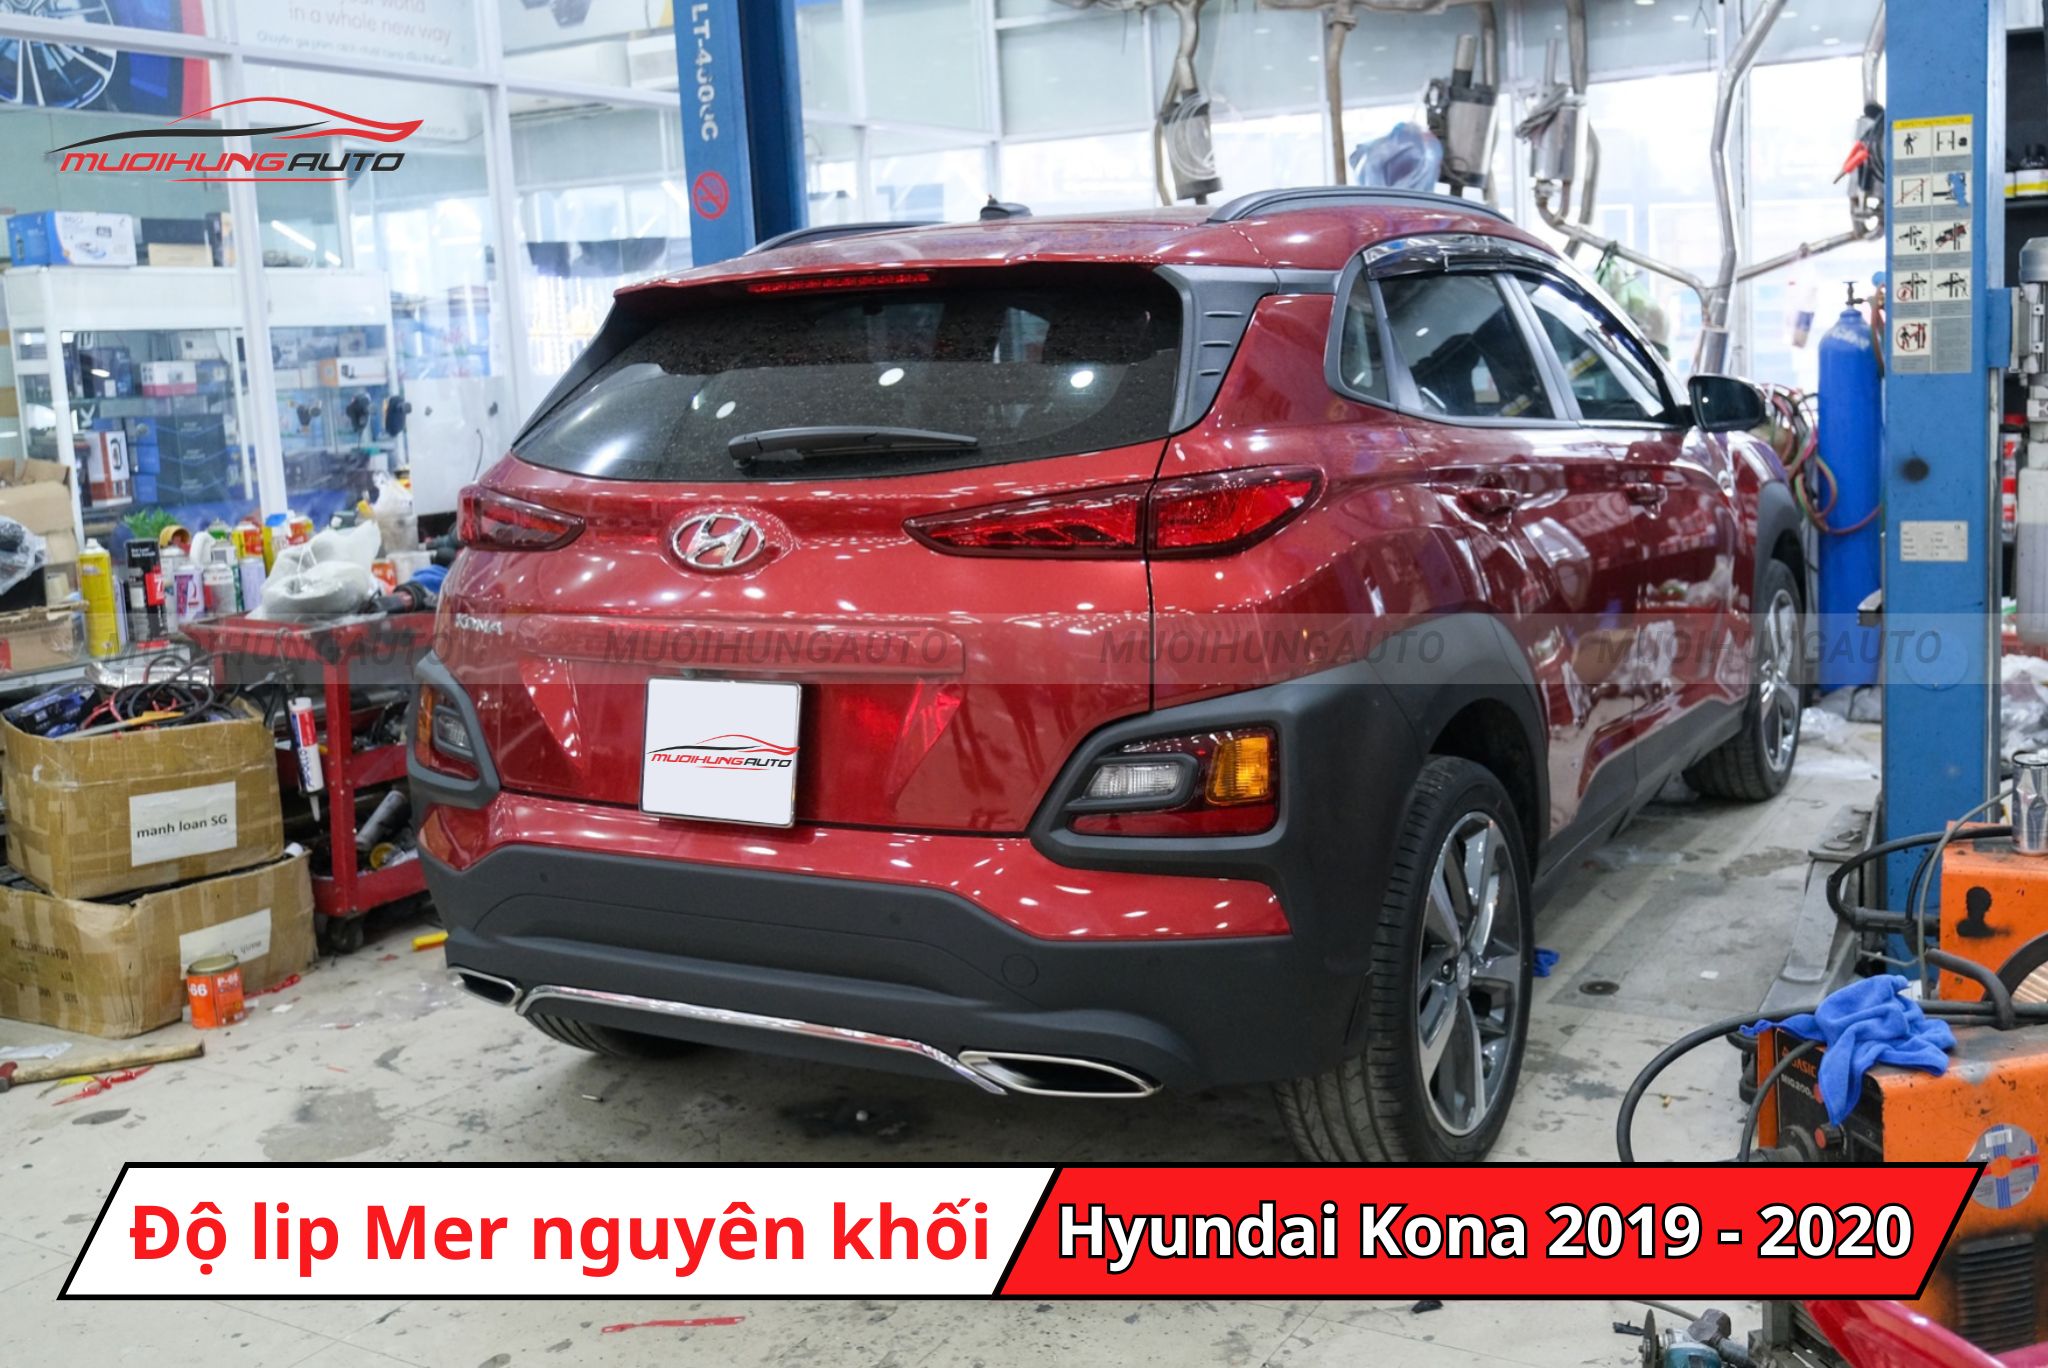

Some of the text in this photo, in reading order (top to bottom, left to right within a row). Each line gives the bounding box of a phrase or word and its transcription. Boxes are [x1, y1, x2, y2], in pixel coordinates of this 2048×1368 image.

[326, 12, 376, 33] whole
[382, 19, 416, 37] new
[418, 25, 453, 47] way
[455, 612, 504, 636] KONA
[136, 814, 228, 839] manh loan SG
